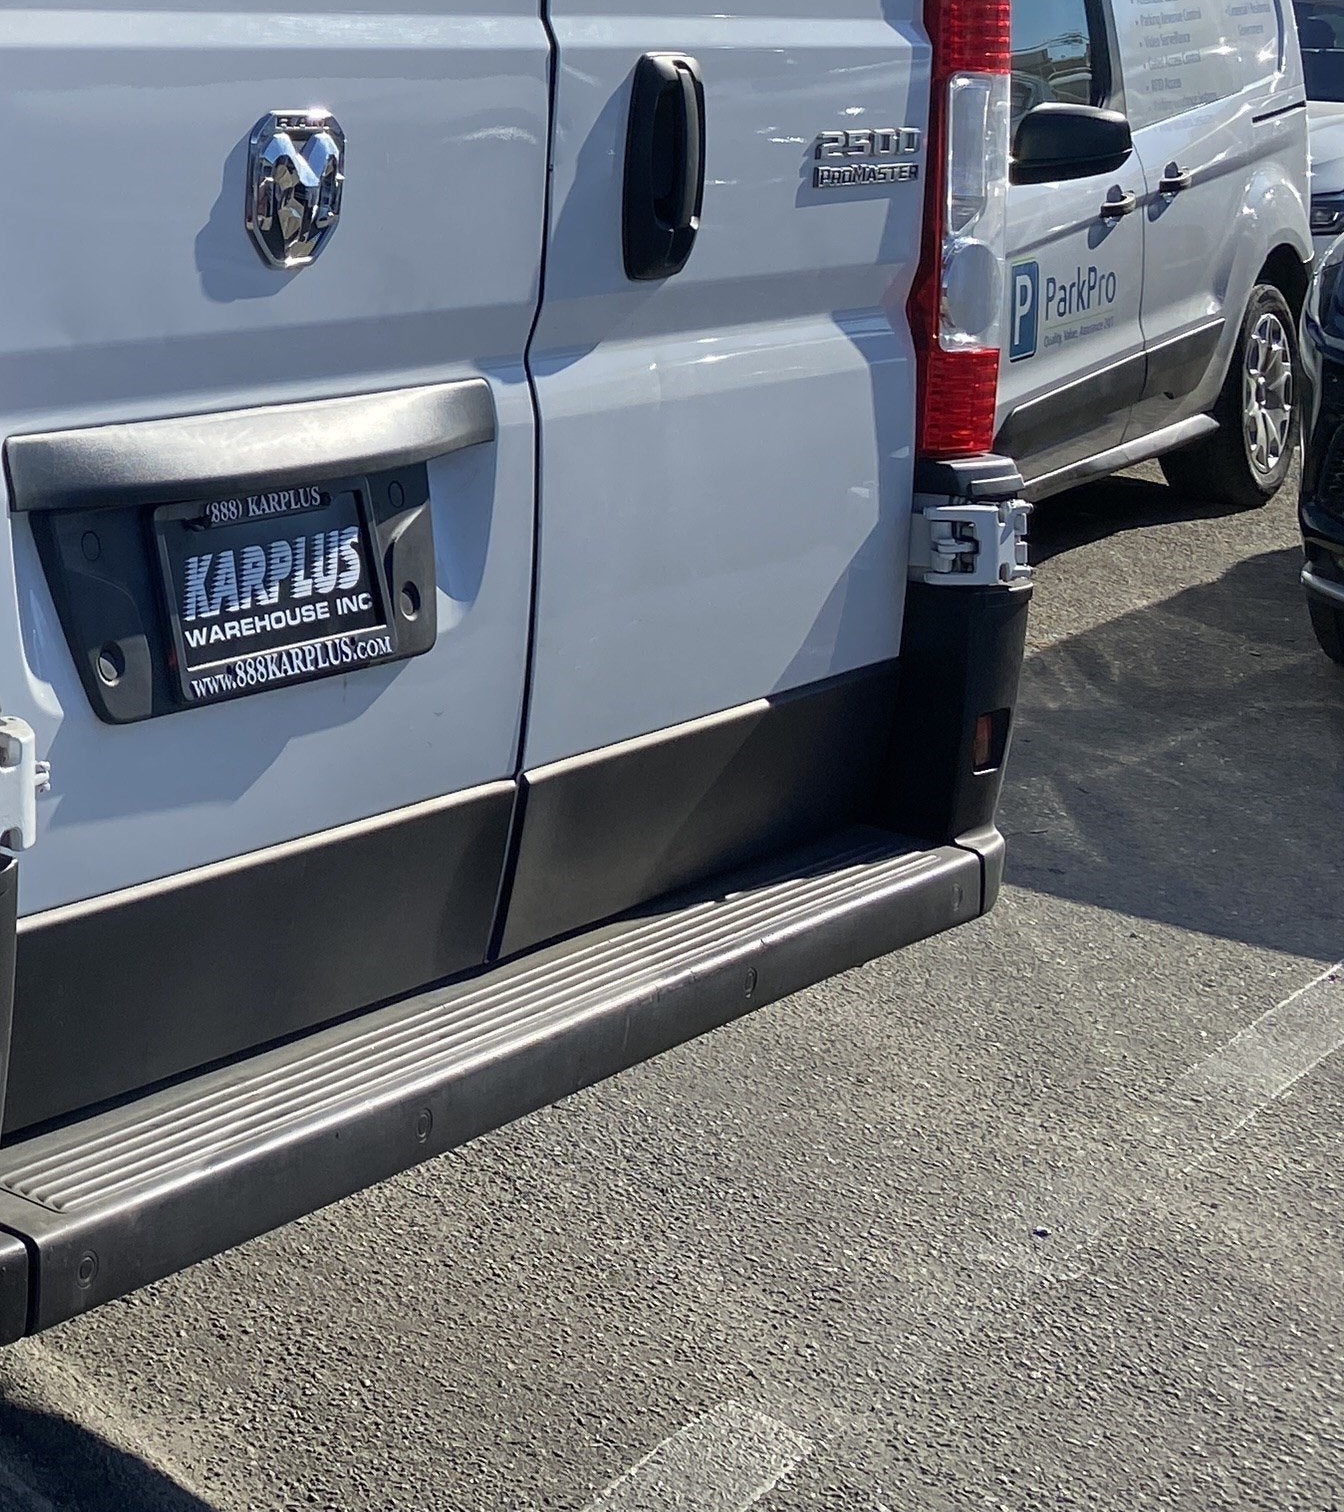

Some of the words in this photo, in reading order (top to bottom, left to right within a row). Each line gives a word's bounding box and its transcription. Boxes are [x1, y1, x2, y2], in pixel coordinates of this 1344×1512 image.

[815, 127, 921, 159] 2500
[1045, 266, 1116, 321] ParkPro
[206, 498, 242, 522] (888)
[247, 486, 321, 516] KARPLUS
[184, 526, 360, 621] KARPLUS
[185, 601, 330, 647] WAREHOUSE
[337, 593, 373, 615] INC
